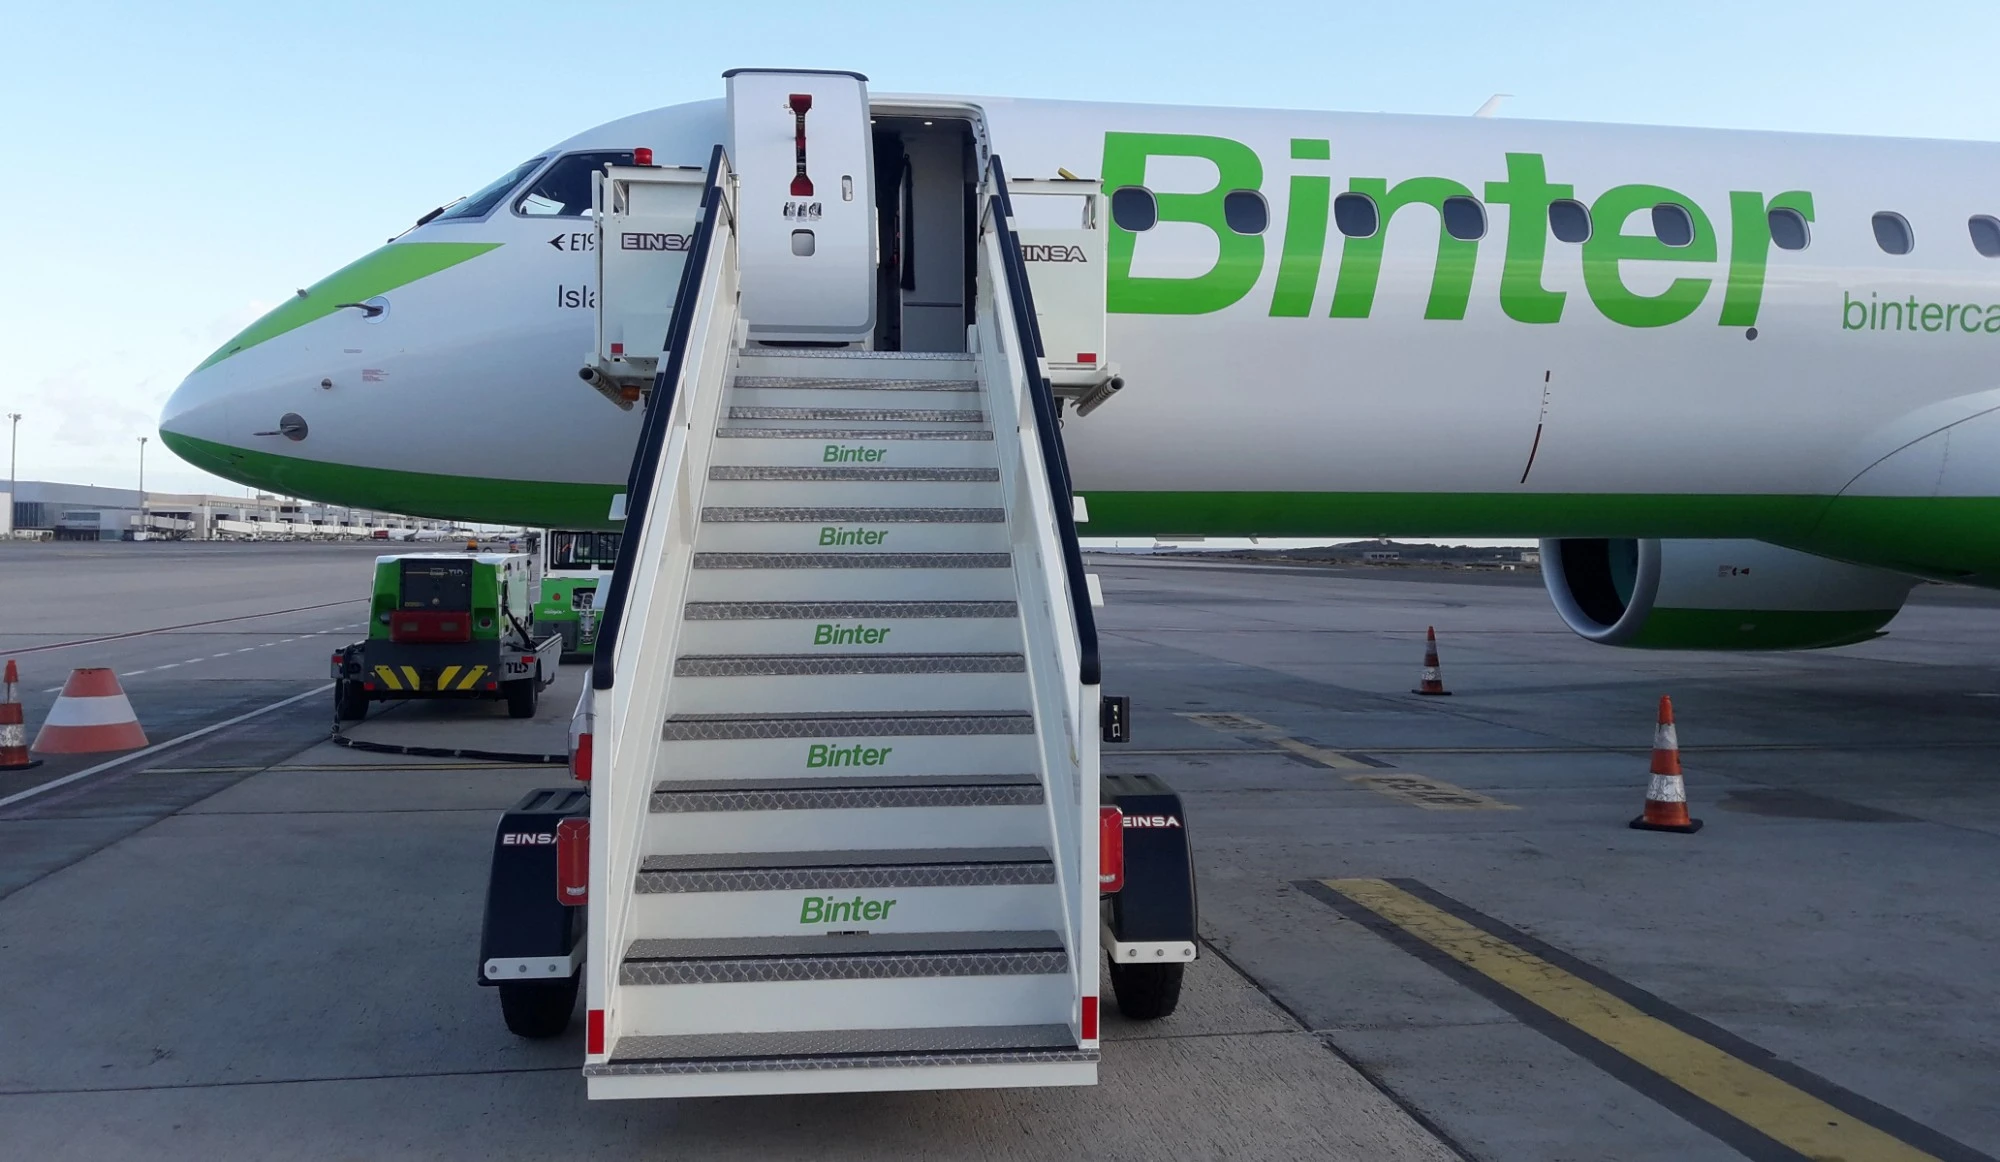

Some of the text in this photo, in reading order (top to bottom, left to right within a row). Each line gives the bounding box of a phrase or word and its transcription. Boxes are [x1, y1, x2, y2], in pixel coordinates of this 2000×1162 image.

[1105, 131, 1816, 328] Binter
[823, 444, 887, 462] Binter
[819, 527, 888, 546] Binter
[813, 623, 891, 645] Binter
[806, 743, 892, 769] Binter
[1122, 816, 1180, 827] EINSA
[800, 895, 896, 924] Binter
